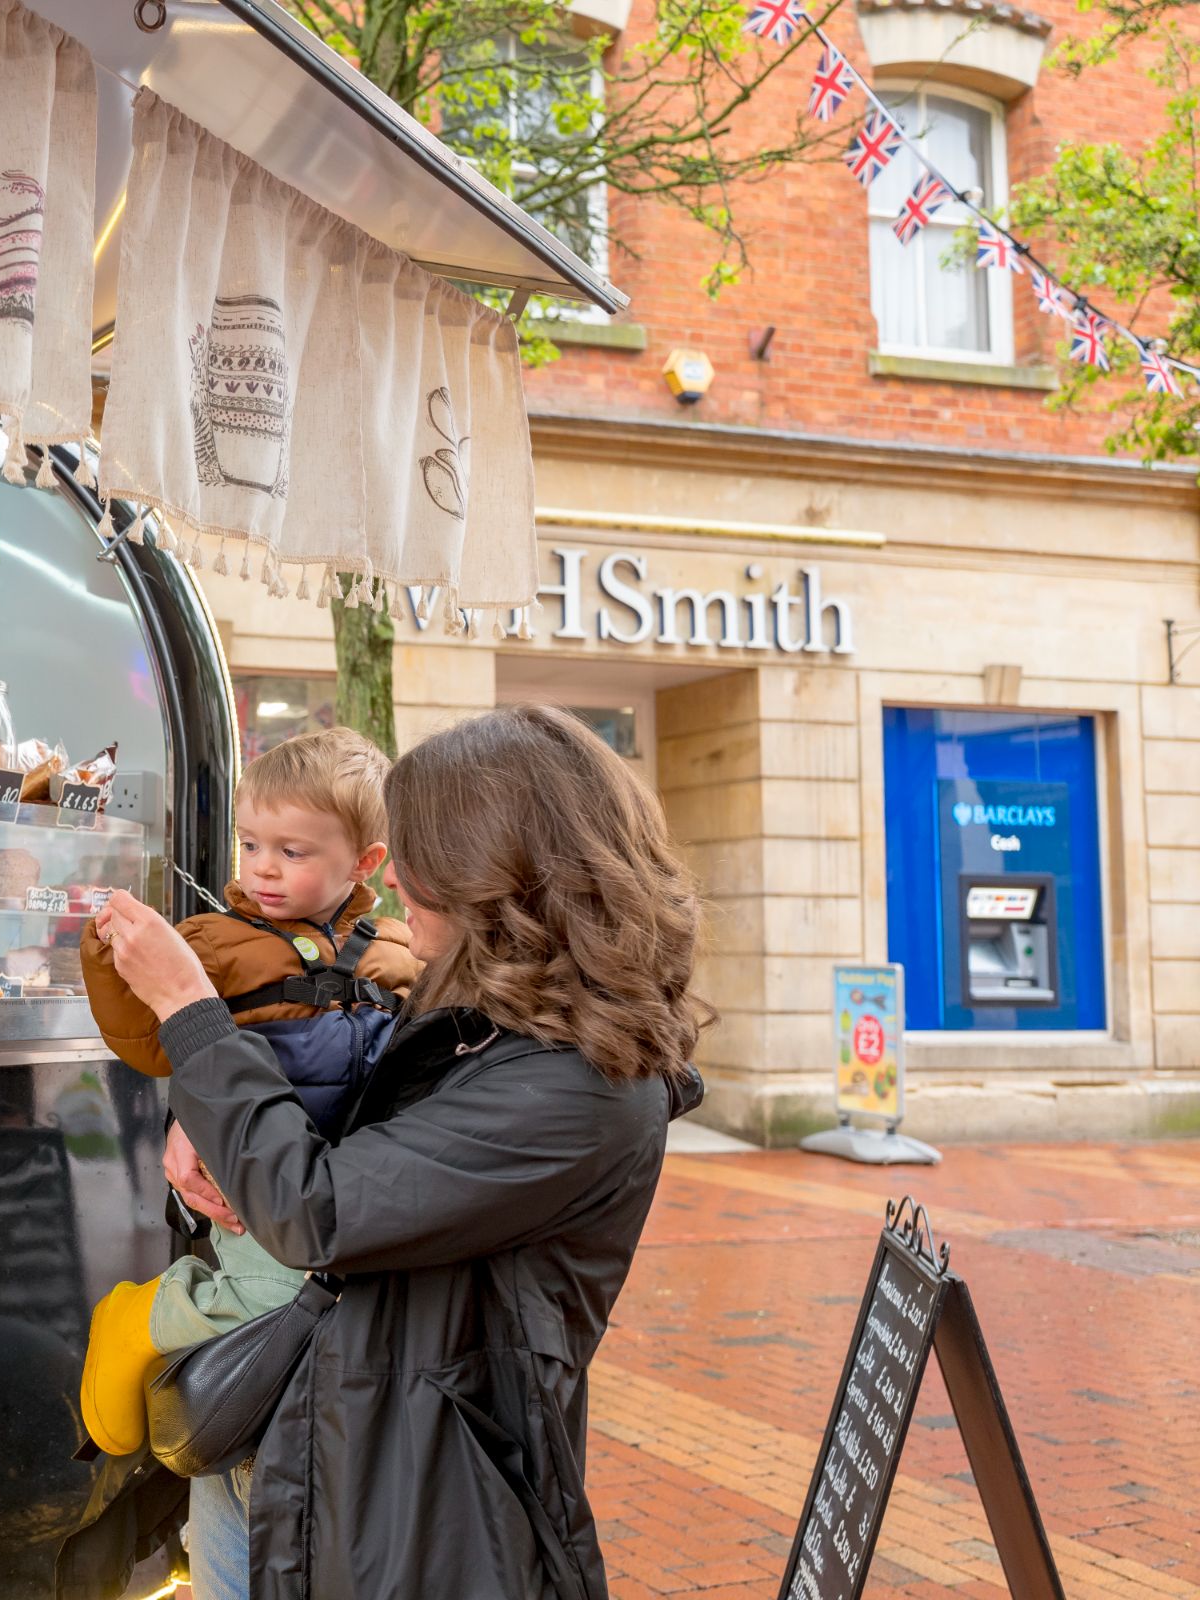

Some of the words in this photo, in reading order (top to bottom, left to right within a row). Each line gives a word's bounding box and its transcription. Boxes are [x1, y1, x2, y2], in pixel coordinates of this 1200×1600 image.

[63, 792, 97, 811] £1.65
[973, 804, 1057, 826] BARCLAYS
[990, 834, 1021, 851] Cash
[858, 1033, 881, 1056] £2
[857, 1337, 875, 1374] Latte
[846, 1367, 868, 1413] Espresso
